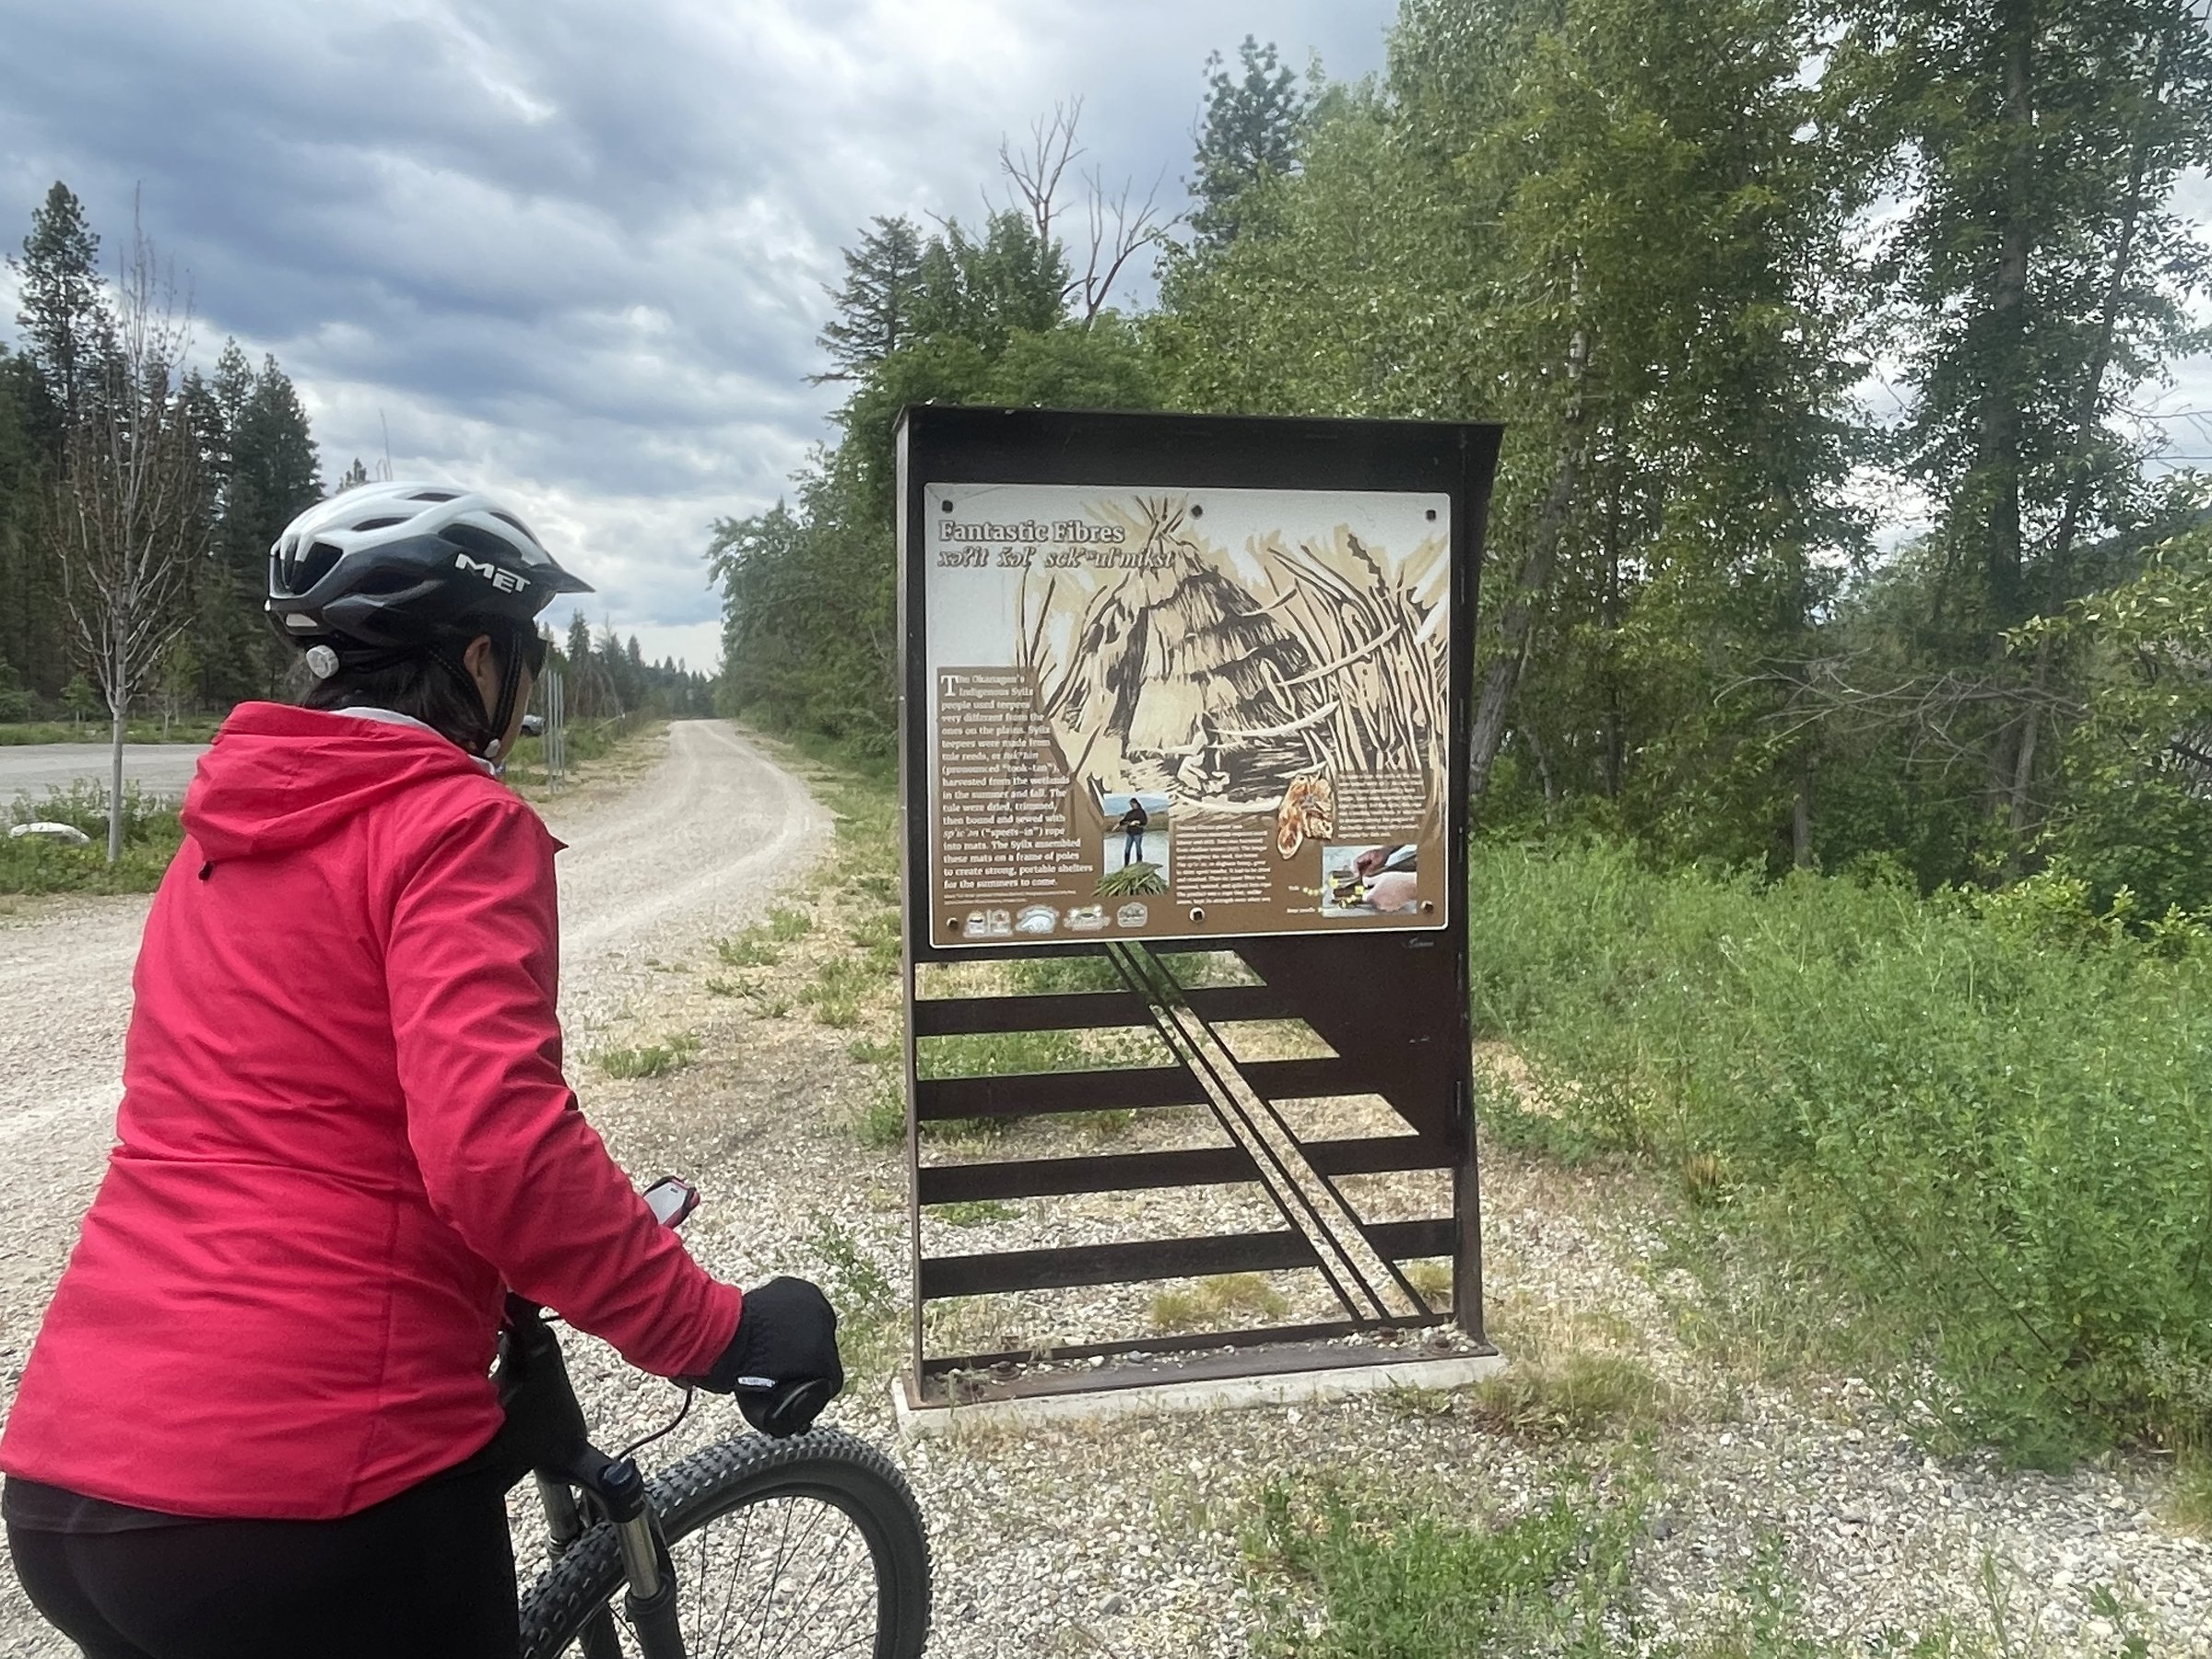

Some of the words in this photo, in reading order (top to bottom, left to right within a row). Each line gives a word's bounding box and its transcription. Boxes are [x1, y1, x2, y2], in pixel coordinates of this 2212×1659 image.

[938, 520, 1049, 543] Fantastic
[1053, 521, 1125, 543] Fibres
[455, 553, 531, 594] MET
[959, 688, 1009, 699] Indigenous
[941, 701, 971, 712] people
[973, 700, 994, 709] used
[941, 714, 961, 724] very
[963, 712, 1003, 722] different
[1005, 712, 1028, 722] from
[1030, 712, 1044, 721] the
[979, 725, 994, 735] the
[1028, 725, 1051, 735] Syilx
[1002, 738, 1027, 747] made
[1029, 738, 1051, 747] from
[942, 752, 959, 761] tule
[962, 752, 989, 761] reeds,
[942, 764, 999, 776] (pronounced
[942, 777, 986, 786] harvested
[988, 777, 1011, 786] from
[1014, 777, 1028, 785] the
[1030, 775, 1070, 785] wetlands
[942, 791, 952, 799] in
[954, 790, 970, 799] the
[971, 791, 1008, 799] summer
[1011, 789, 1028, 798] and
[1049, 788, 1067, 797] The
[942, 804, 960, 812] tule
[987, 802, 1013, 812] dried,
[942, 816, 964, 825] then
[965, 815, 994, 825] bound
[996, 815, 1013, 824] and
[1015, 814, 1043, 823] sewed
[1044, 813, 1065, 822] with
[1044, 827, 1065, 838] rope
[943, 841, 961, 851] into
[964, 841, 988, 850] mats.
[991, 840, 1007, 849] The
[1010, 840, 1033, 851] Syilx
[1035, 839, 1080, 848] assembled
[943, 854, 967, 864] these
[970, 853, 993, 863] mats
[1016, 852, 1042, 861] frame
[1044, 851, 1054, 860] of
[1055, 852, 1079, 862] poles
[943, 867, 953, 877] to
[955, 866, 982, 876] create
[984, 865, 1017, 877] strong,
[1019, 864, 1055, 876] portable
[1058, 863, 1093, 873] shelters
[944, 879, 957, 889] for
[959, 879, 974, 888] the
[977, 878, 1018, 888] summers
[1020, 877, 1030, 887] to
[1031, 877, 1057, 887] come.
